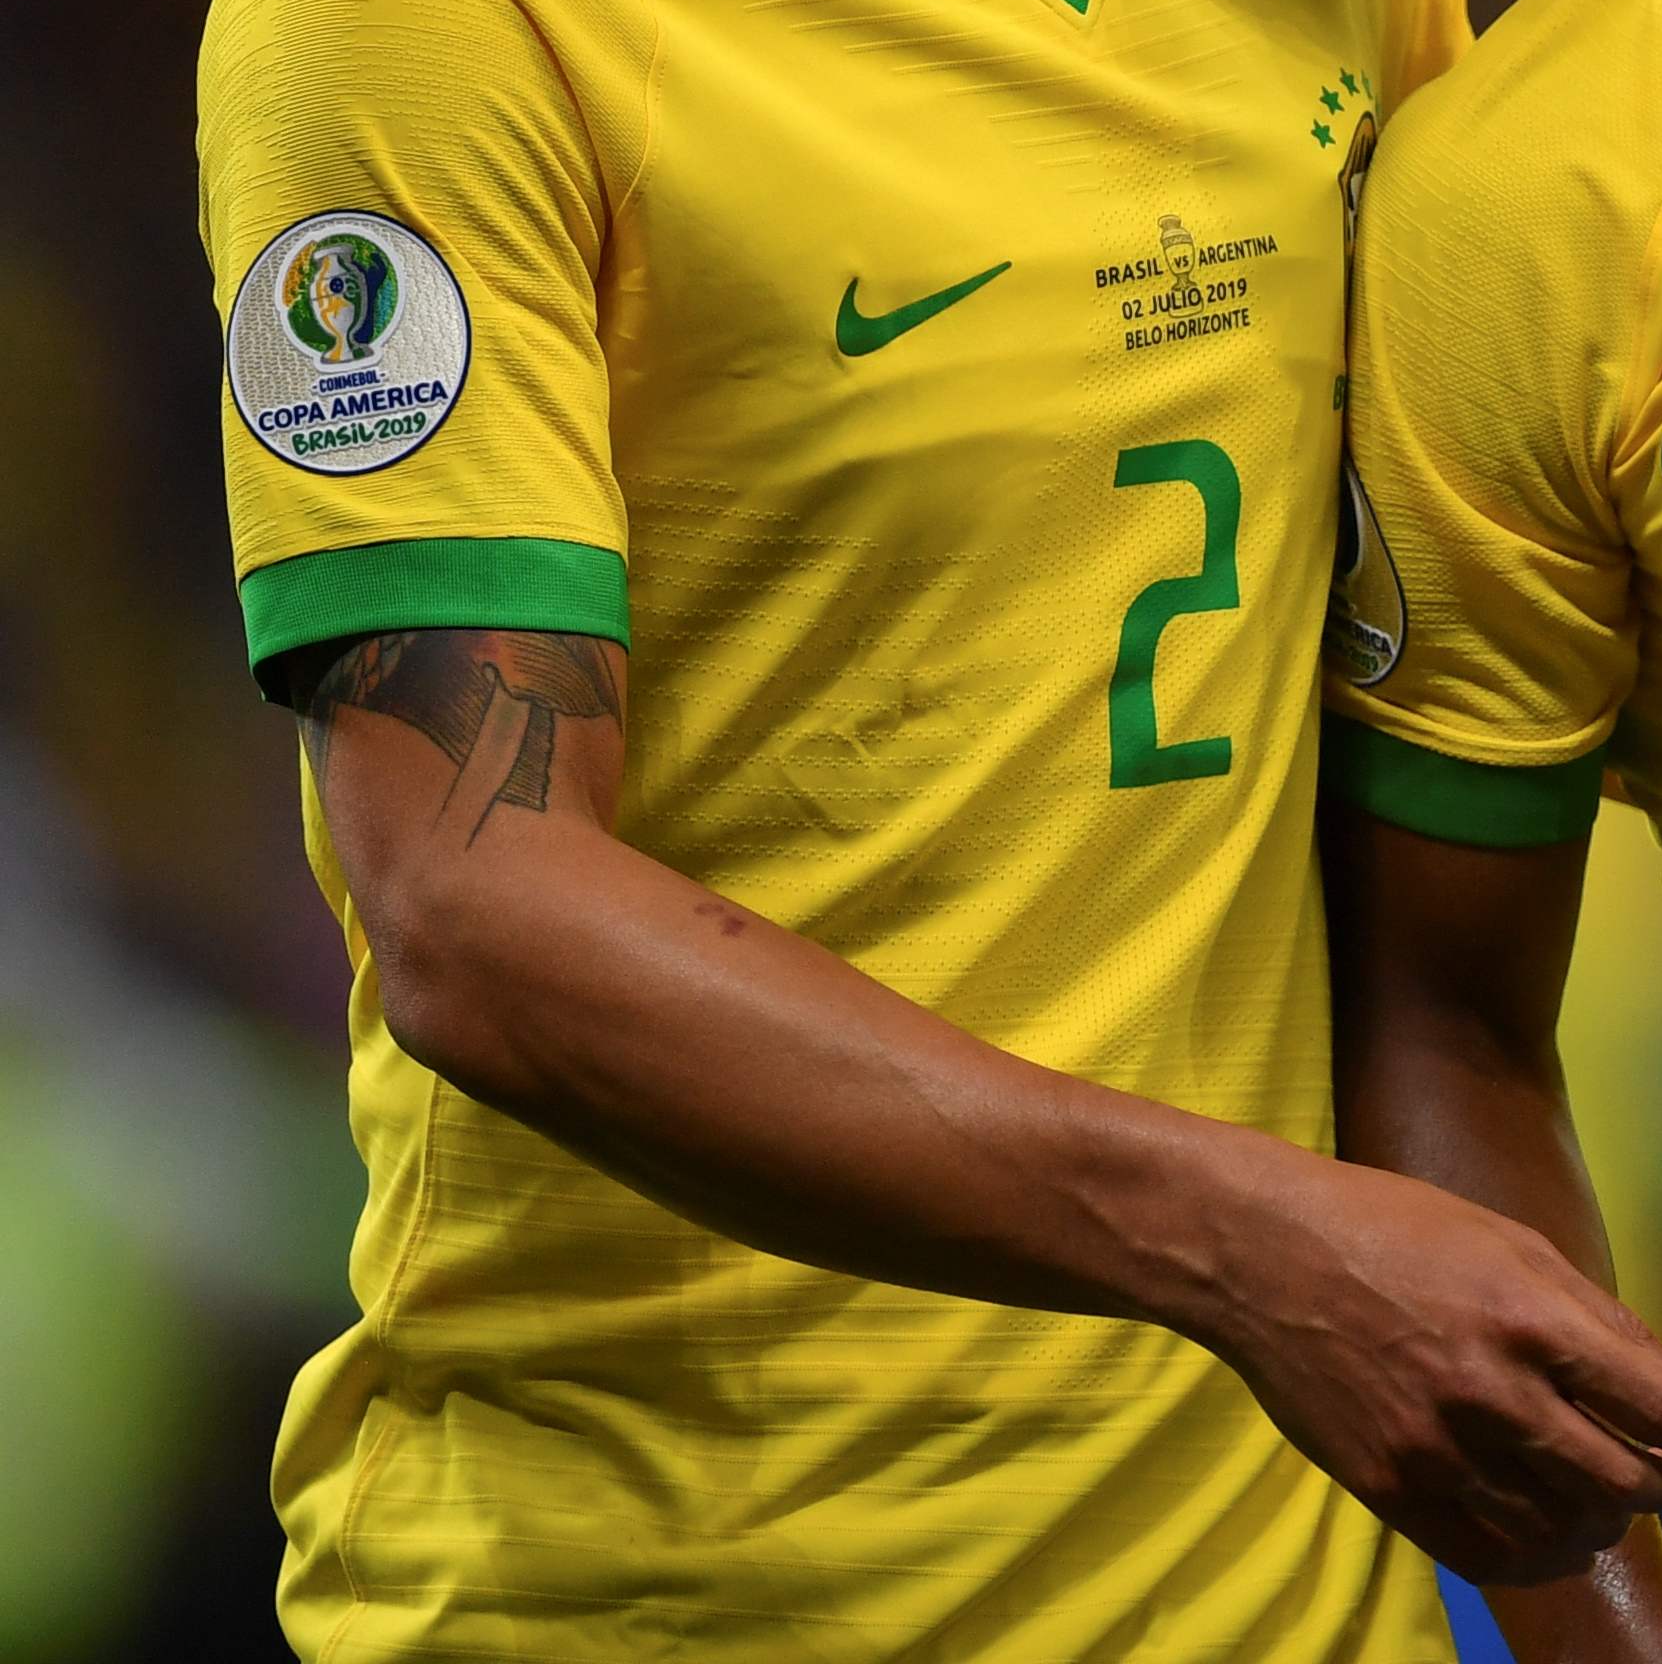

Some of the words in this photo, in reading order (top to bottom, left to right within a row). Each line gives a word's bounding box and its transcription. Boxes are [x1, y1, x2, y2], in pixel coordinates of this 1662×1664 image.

[1095, 257, 1164, 288] BRASIL
[1199, 234, 1278, 268] ARGENTINA
[1122, 299, 1144, 320] 02
[1149, 287, 1202, 316] JULIO
[1206, 277, 1248, 304] 2019
[1125, 326, 1163, 351] BELO
[1166, 308, 1251, 343] HORIZONTE
[258, 401, 327, 432] COPA
[331, 380, 449, 419] AMERICA
[373, 411, 427, 439] 2019
[1108, 439, 1242, 789] 2
